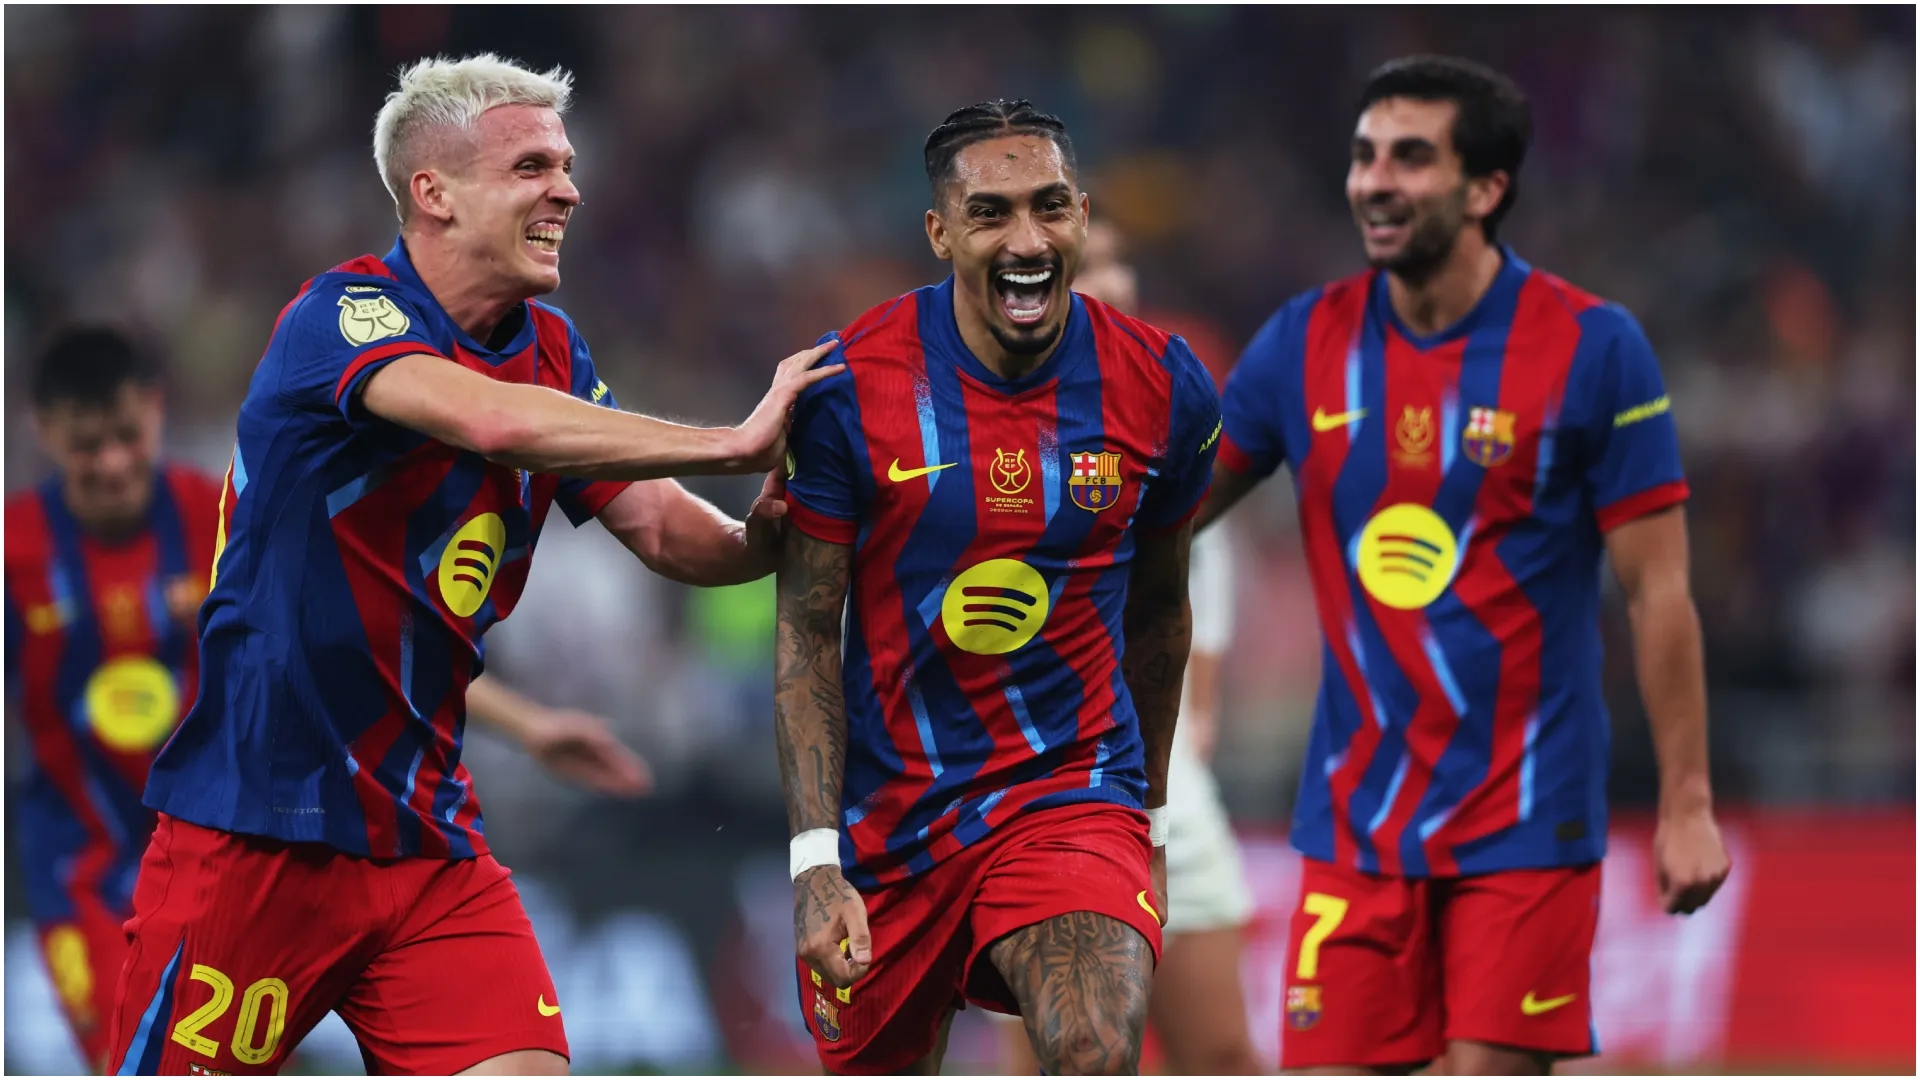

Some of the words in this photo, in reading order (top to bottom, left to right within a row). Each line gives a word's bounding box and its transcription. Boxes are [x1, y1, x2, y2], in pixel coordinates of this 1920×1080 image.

[985, 496, 1034, 505] SUPERCOPA
[1296, 892, 1348, 979] 7
[171, 963, 290, 1065] 20
